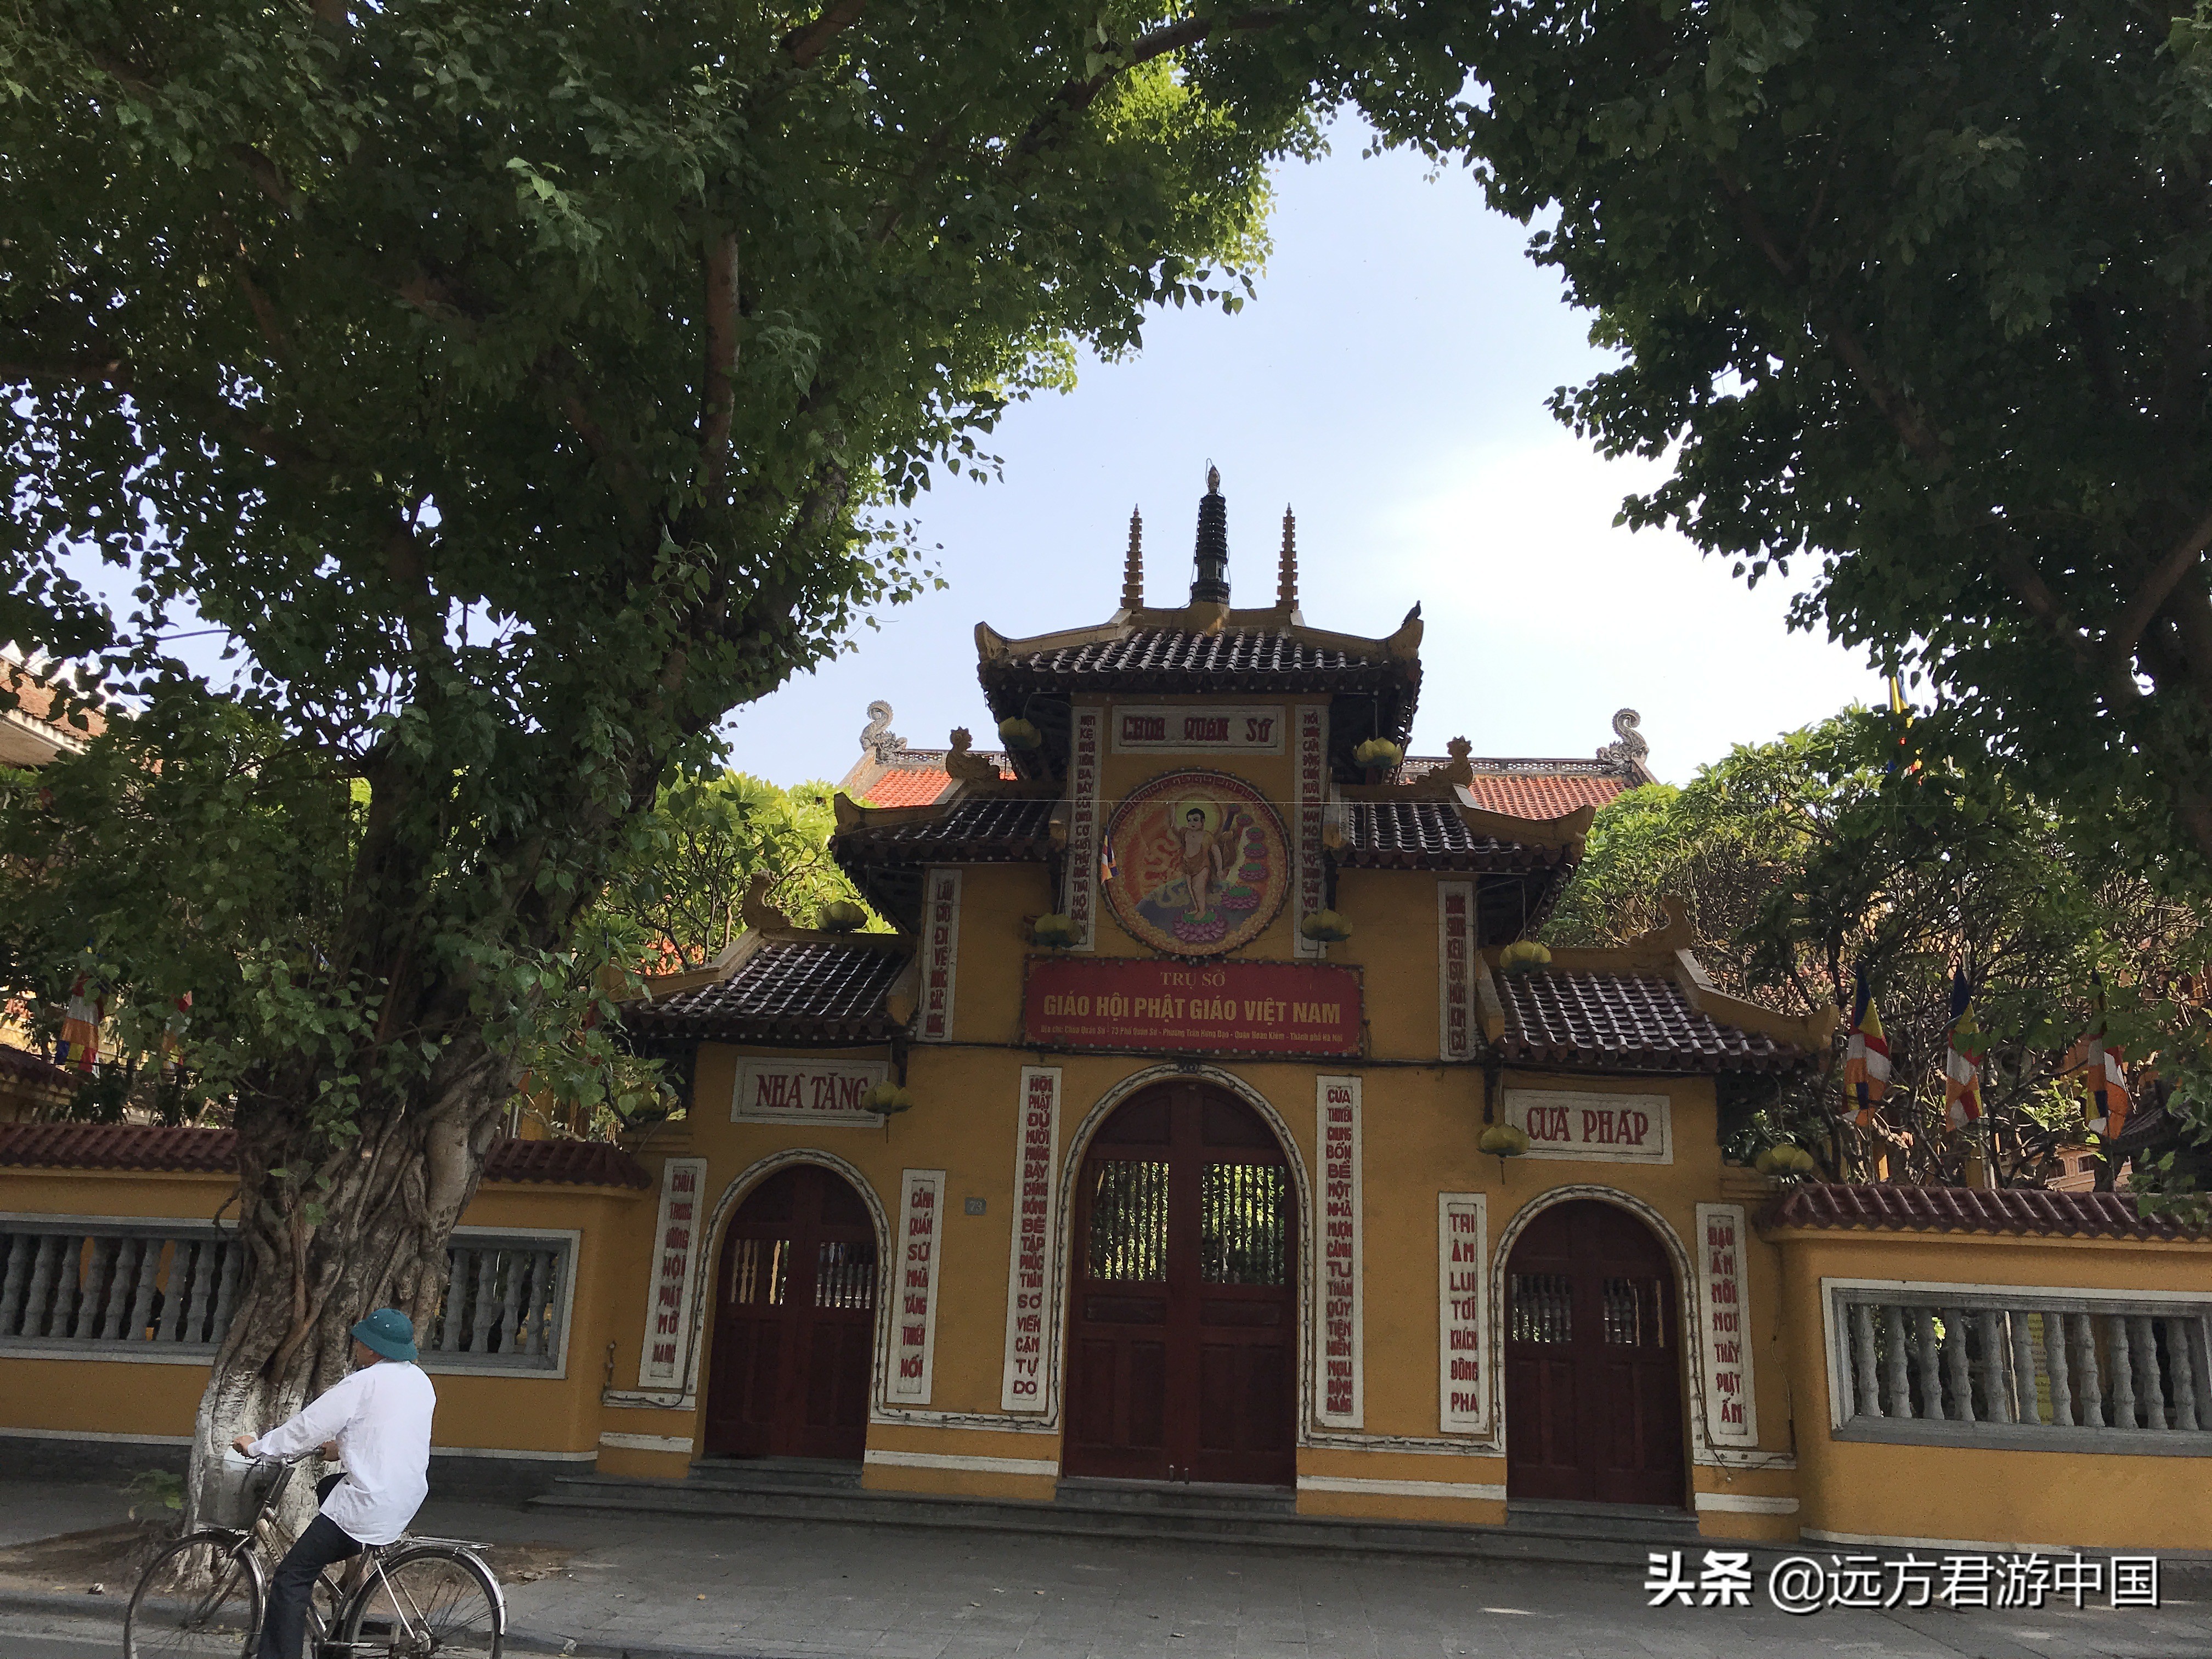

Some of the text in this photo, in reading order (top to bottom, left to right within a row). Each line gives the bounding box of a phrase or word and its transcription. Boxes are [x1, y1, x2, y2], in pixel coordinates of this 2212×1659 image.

[1160, 968, 1227, 990] TRỤ SỞ
[1043, 991, 1341, 1025] GIÁO HỘI PHẬT GIÁO VIỆT NAM
[1111, 1027, 1119, 1035] 73
[810, 1072, 868, 1110] TĂNG
[1582, 1109, 1649, 1146] PHÁP
[1326, 1142, 1352, 1159] BỐN
[1327, 1180, 1351, 1200] MỘT
[969, 1200, 982, 1211] 73
[909, 1212, 933, 1236] QUÁN
[1449, 1214, 1475, 1233] TRI
[1452, 1239, 1475, 1262] ÂM
[1450, 1272, 1476, 1292] LUI
[1451, 1296, 1476, 1321] TỚI
[1327, 1360, 1352, 1376] NGU
[1013, 1381, 1037, 1395] DO
[1450, 1392, 1479, 1413] PHA
